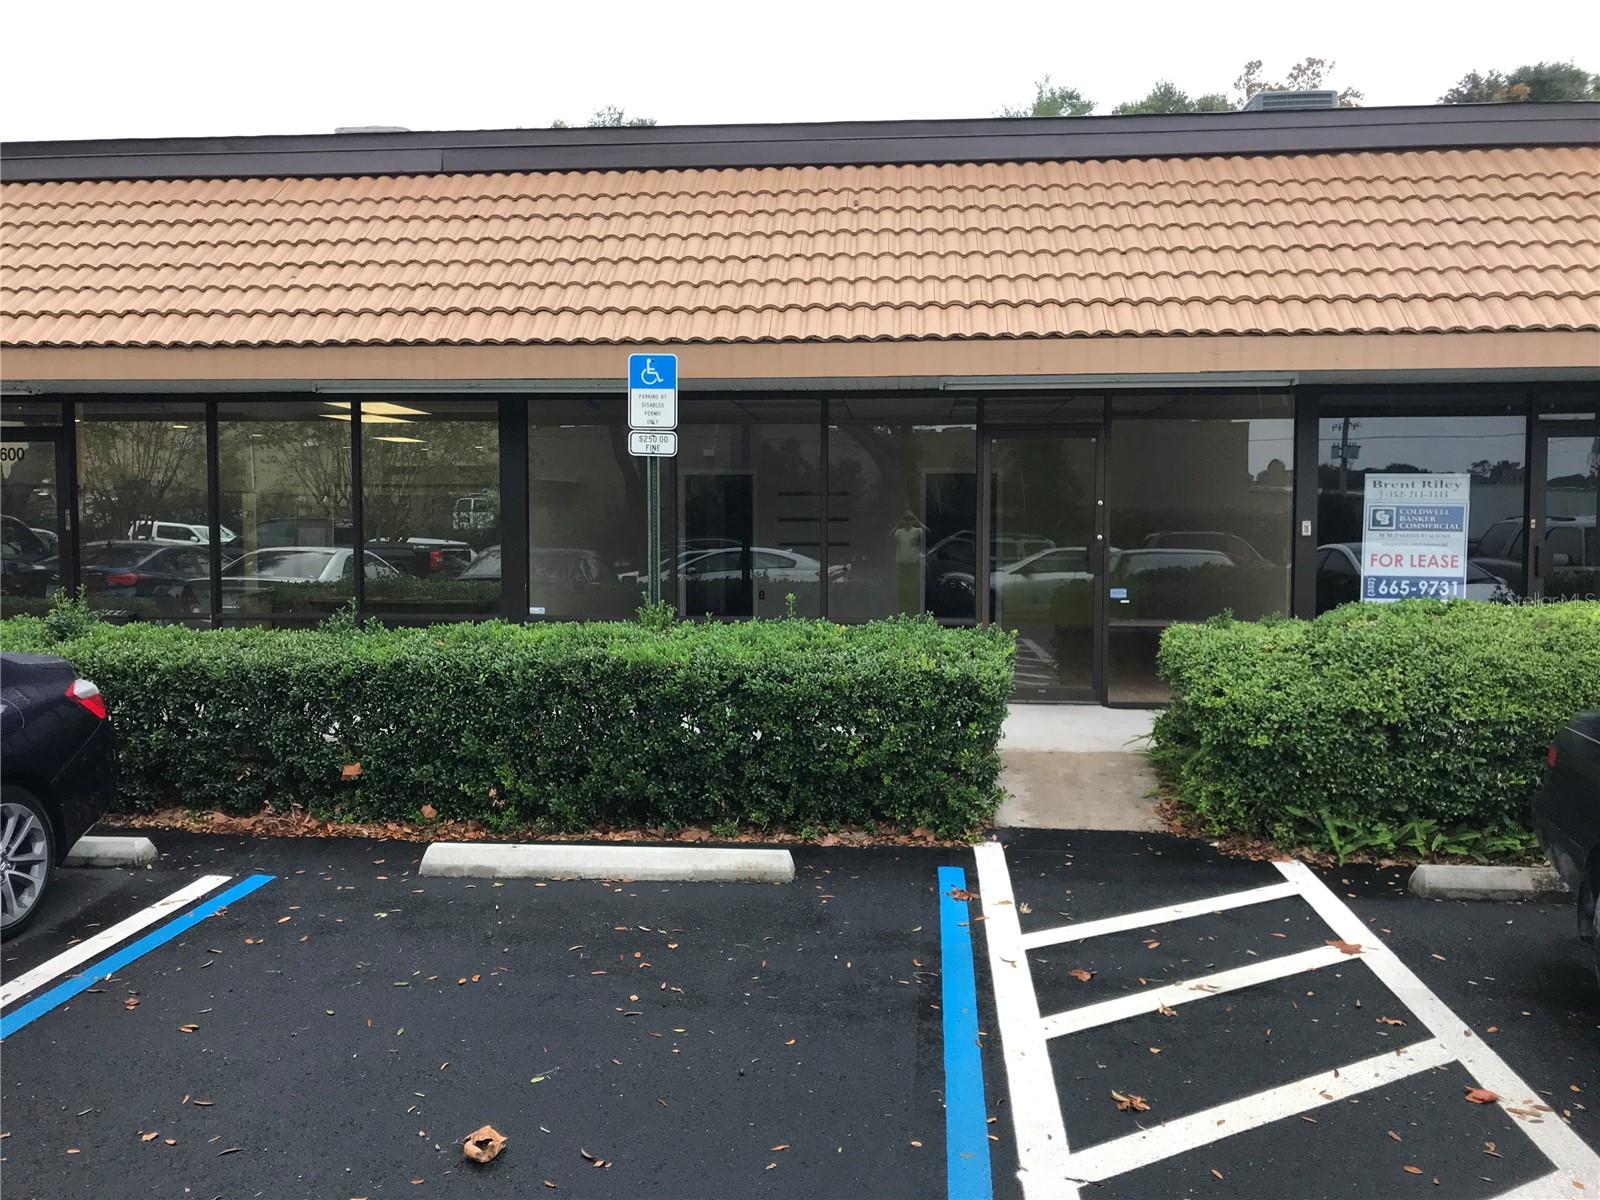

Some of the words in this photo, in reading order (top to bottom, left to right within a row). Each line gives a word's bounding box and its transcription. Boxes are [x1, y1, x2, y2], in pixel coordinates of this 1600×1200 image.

[638, 435, 669, 443] $250.00
[0, 447, 25, 461] 600
[645, 444, 661, 452] FINE
[1372, 480, 1415, 489] Brent
[1422, 480, 1463, 491] Riley
[1370, 553, 1404, 568] FOR
[1410, 554, 1459, 568] LEASE
[1378, 580, 1459, 595] 665-9731
